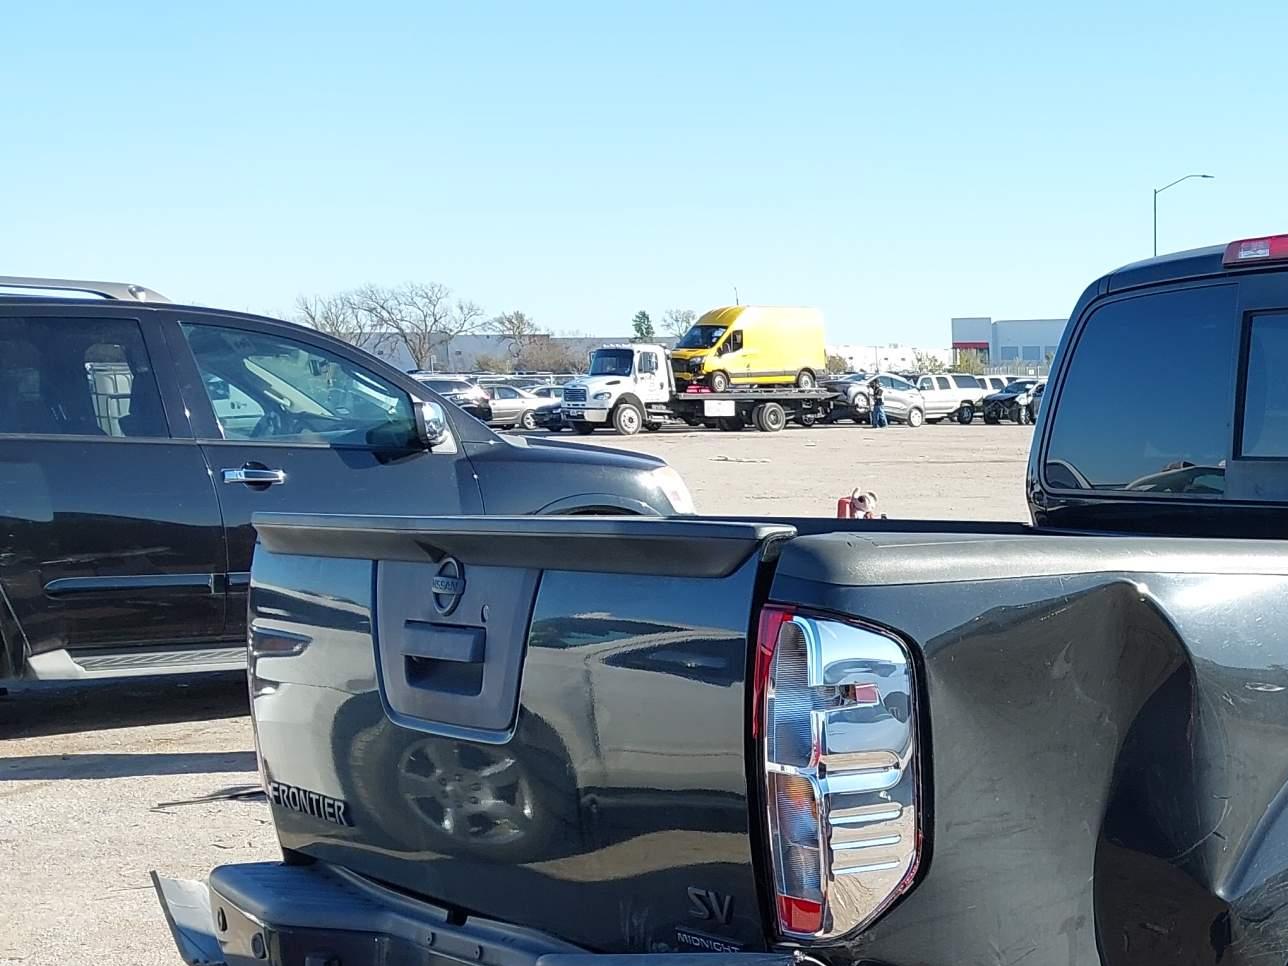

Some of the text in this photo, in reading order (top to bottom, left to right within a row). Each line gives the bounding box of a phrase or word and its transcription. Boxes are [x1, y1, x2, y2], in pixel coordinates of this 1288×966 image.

[270, 781, 347, 826] FRONTIER
[688, 886, 732, 924] SV
[677, 932, 741, 953] MIDNIGHT
